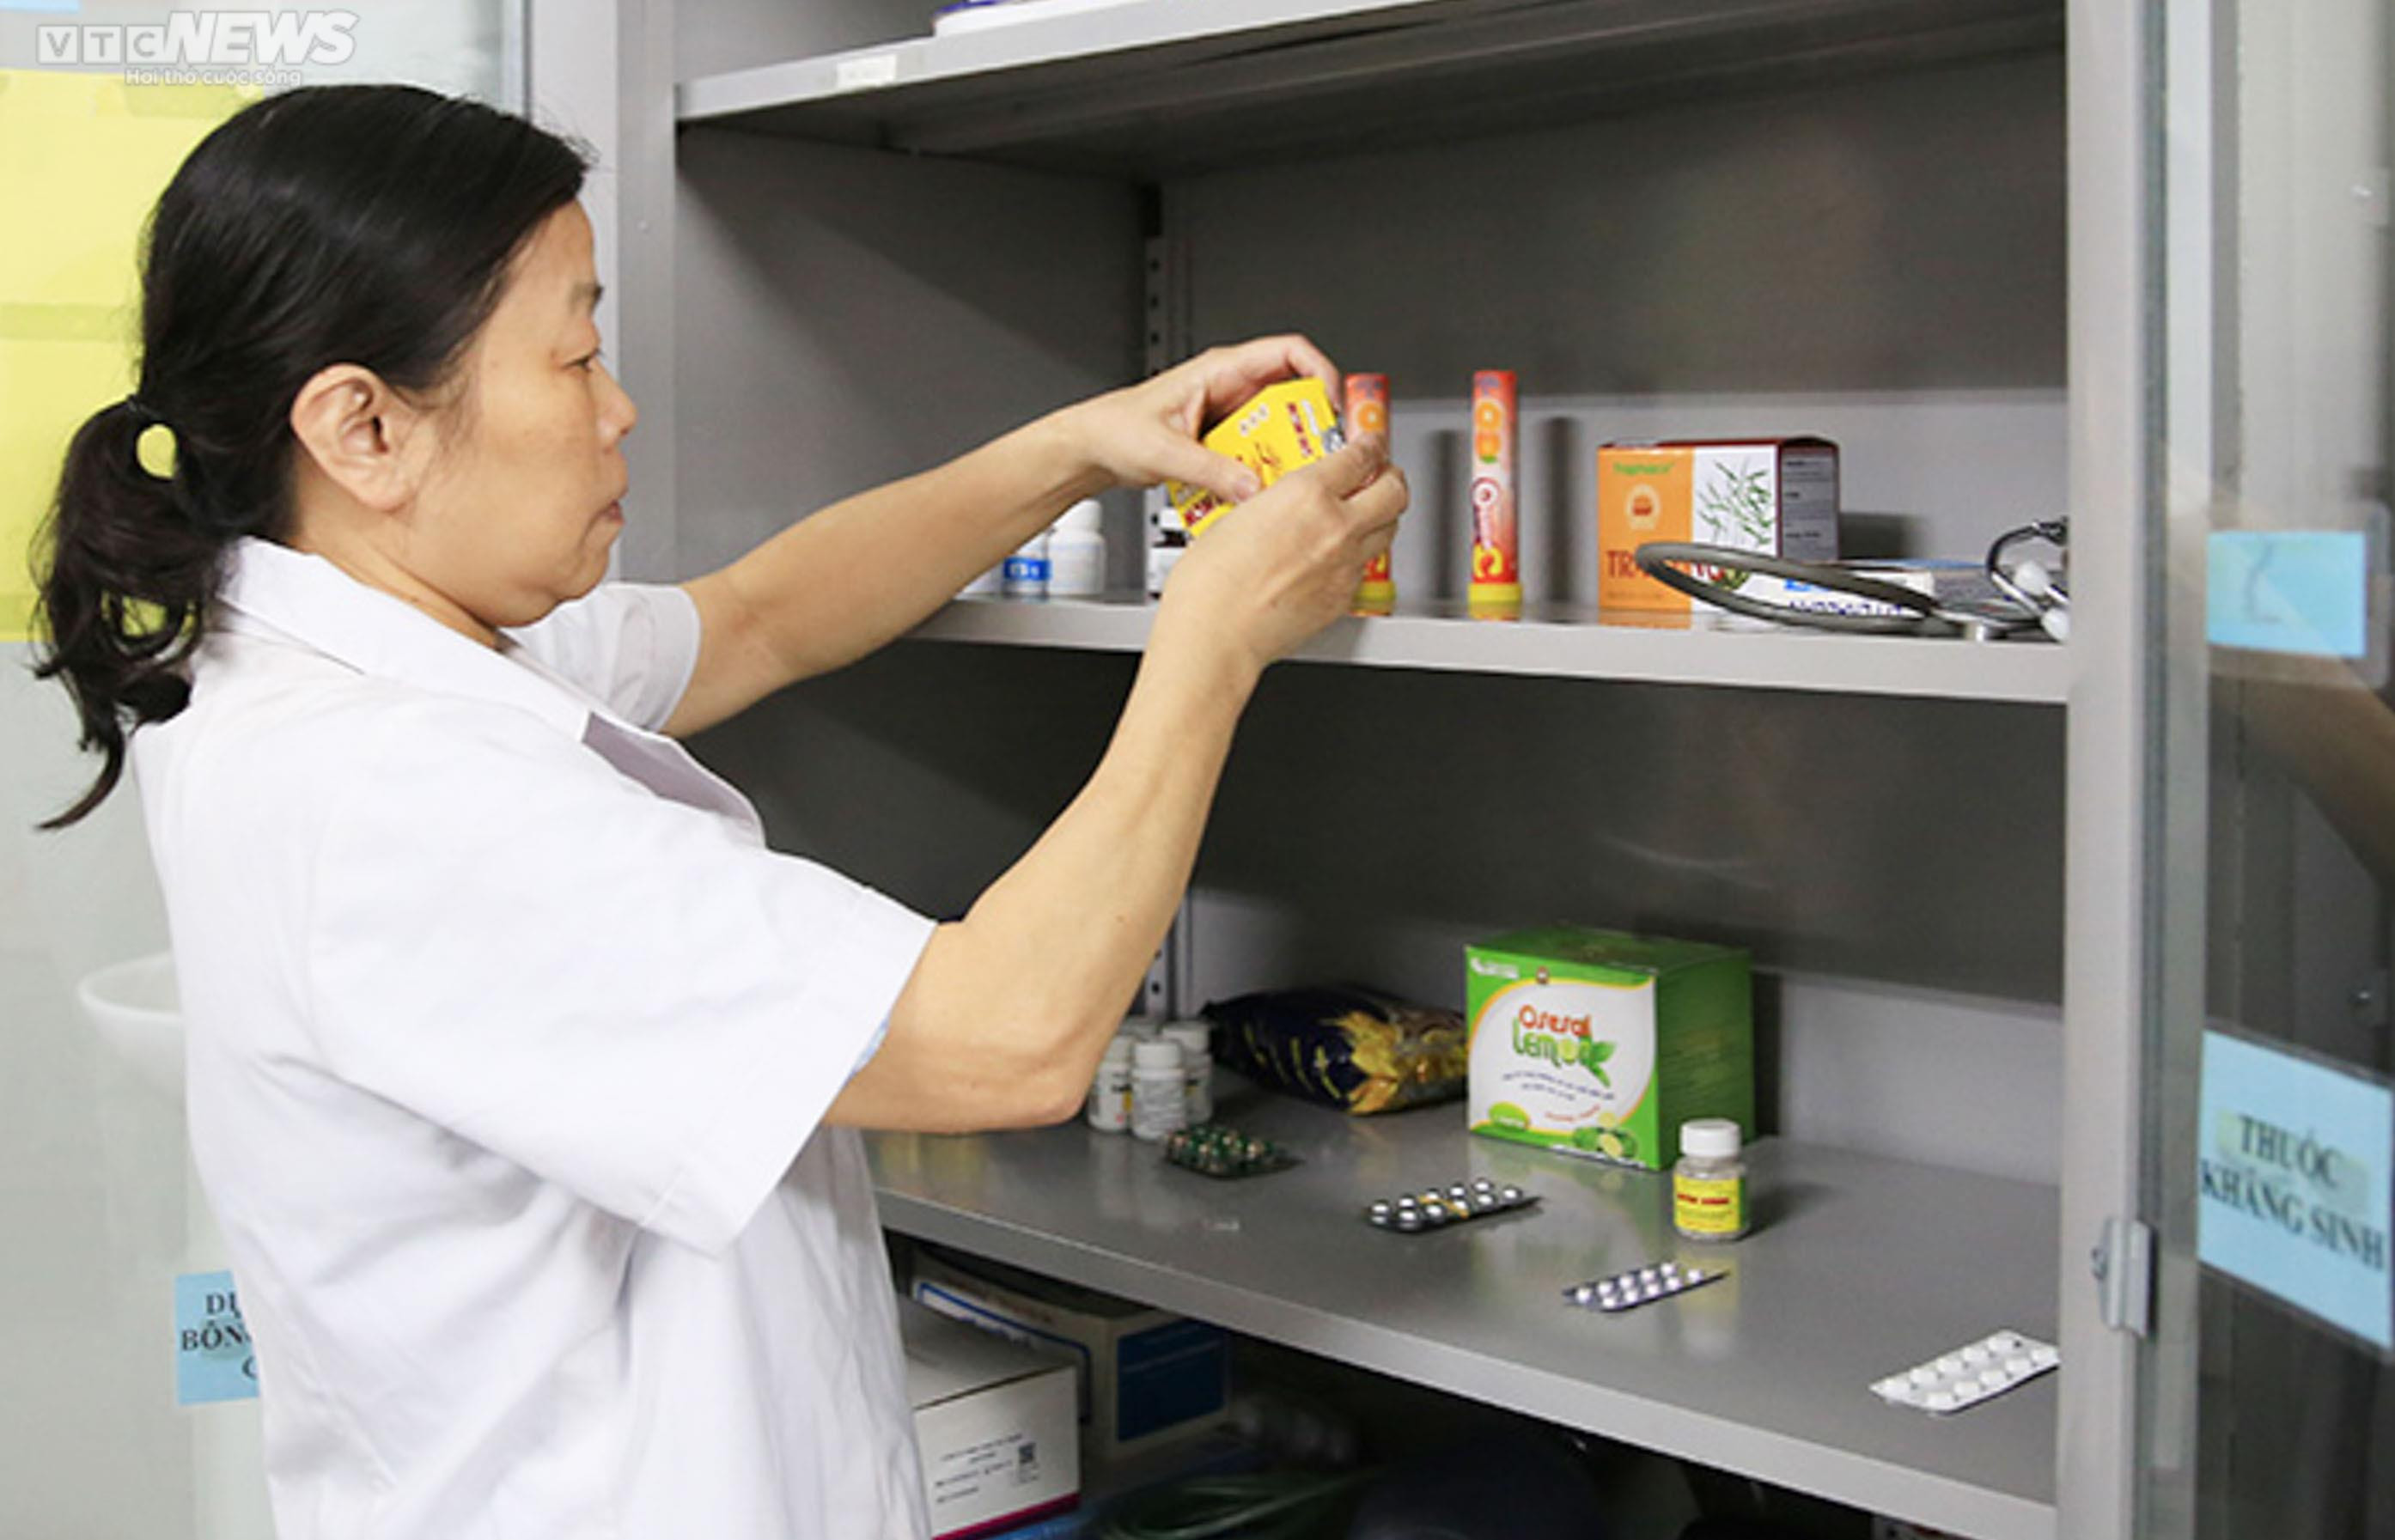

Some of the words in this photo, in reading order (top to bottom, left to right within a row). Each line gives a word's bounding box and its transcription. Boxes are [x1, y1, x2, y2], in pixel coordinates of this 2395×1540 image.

[2240, 1114, 2343, 1190] THUỐC
[2200, 1159, 2305, 1234] KHÁNG
[2310, 1205, 2385, 1273] SINH
